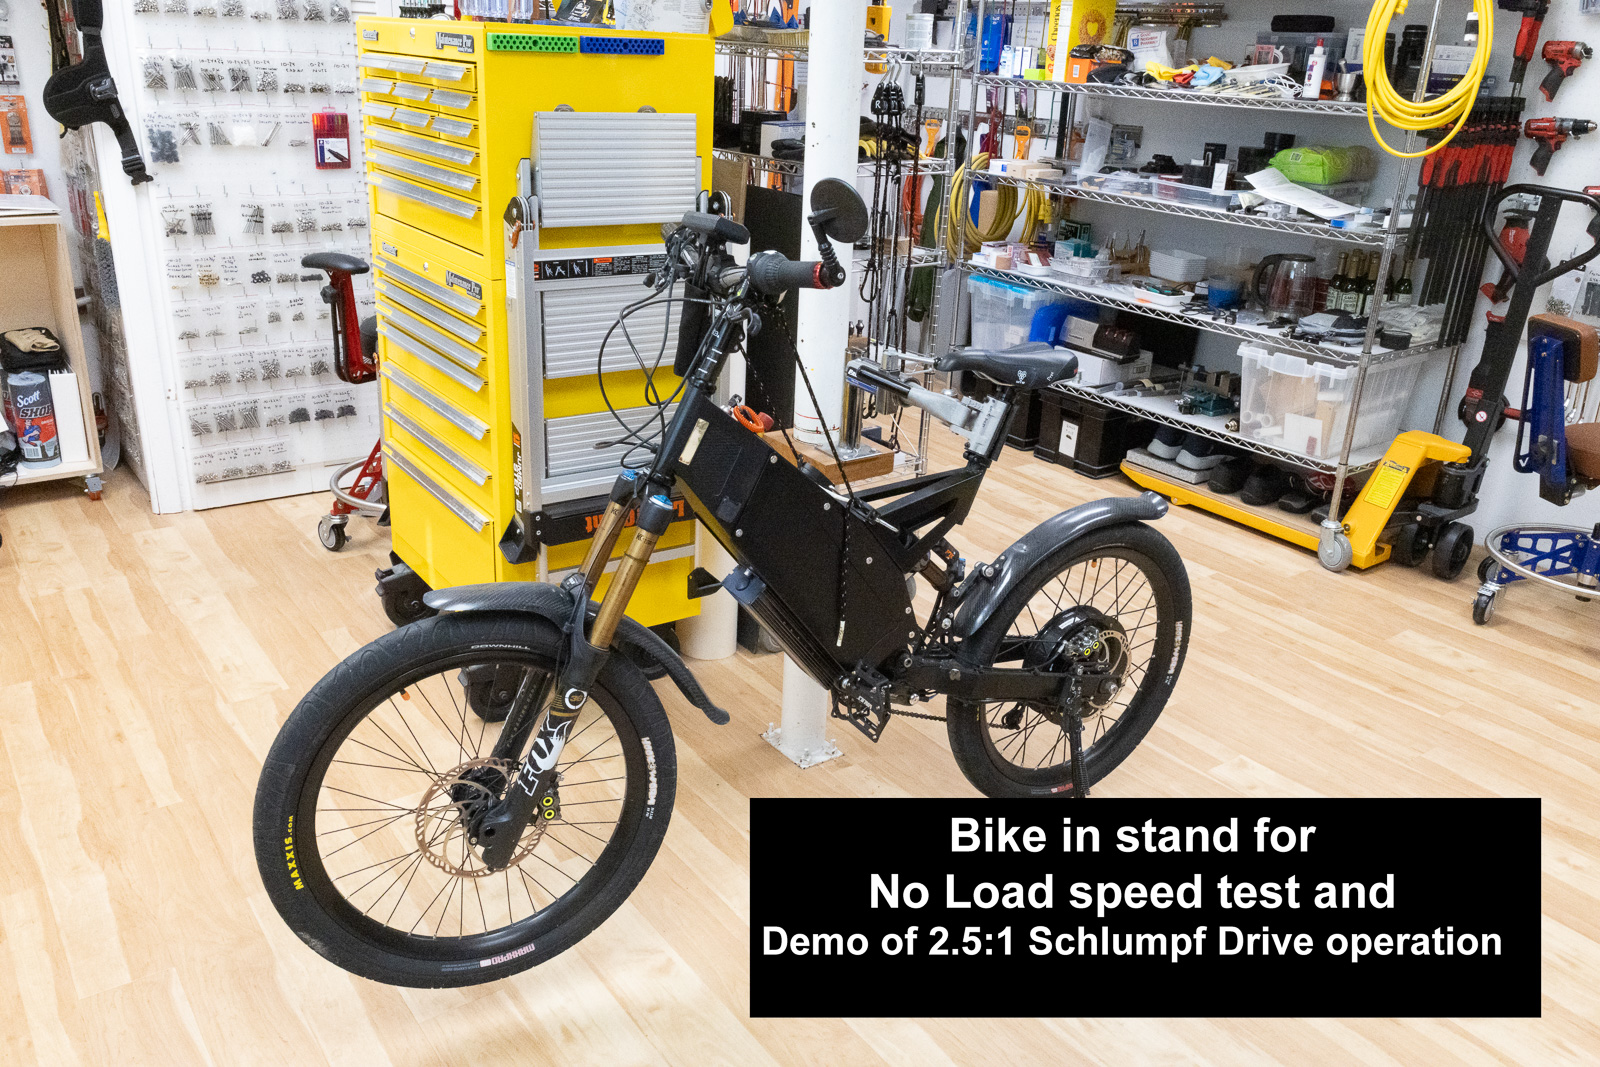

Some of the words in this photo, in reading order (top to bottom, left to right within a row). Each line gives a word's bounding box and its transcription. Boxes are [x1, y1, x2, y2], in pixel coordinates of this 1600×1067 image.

[17, 391, 40, 408] Scott
[570, 694, 584, 702] 36
[518, 710, 573, 797] FOX
